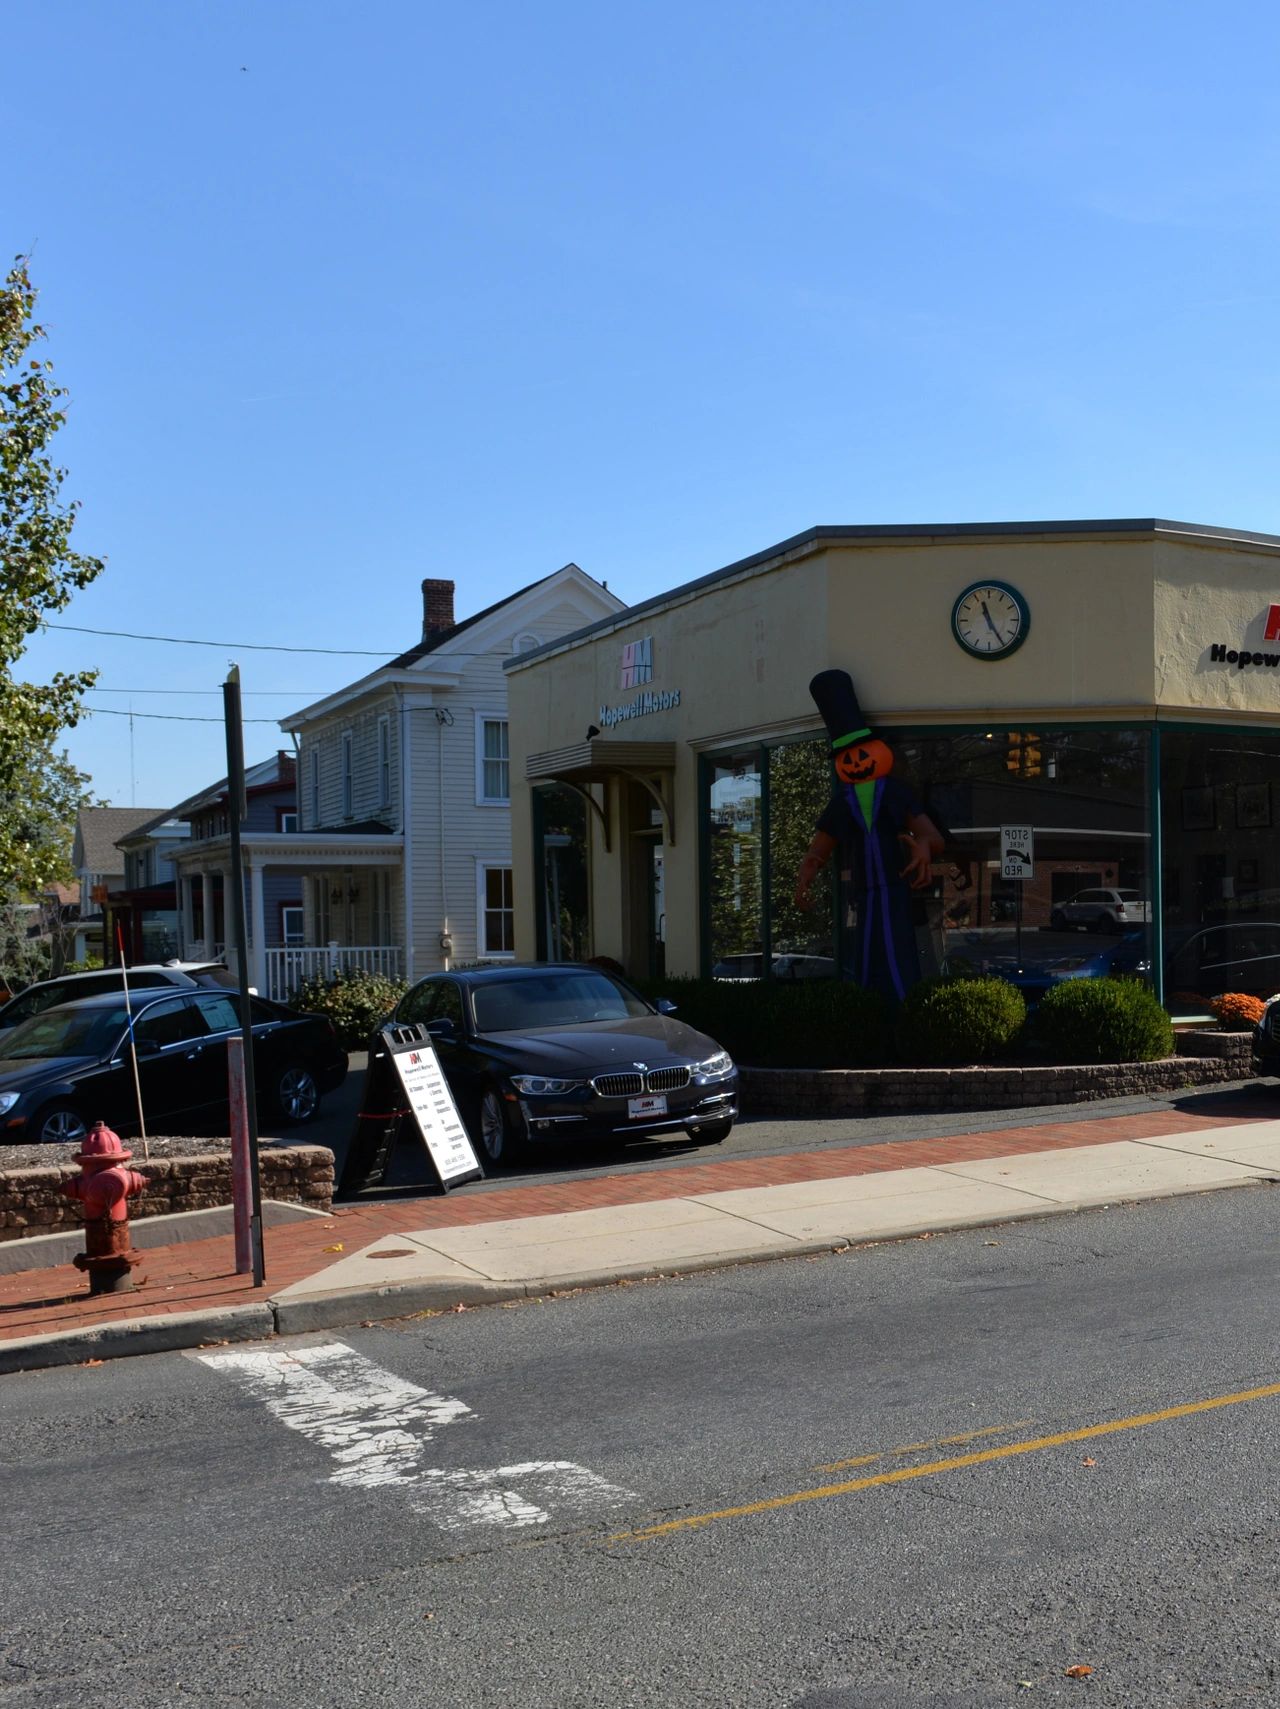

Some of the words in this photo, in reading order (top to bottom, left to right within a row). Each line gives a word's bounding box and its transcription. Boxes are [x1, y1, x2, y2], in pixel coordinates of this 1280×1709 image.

[621, 637, 653, 690] HM
[600, 693, 642, 729] Hopewell
[643, 689, 681, 715] Motors
